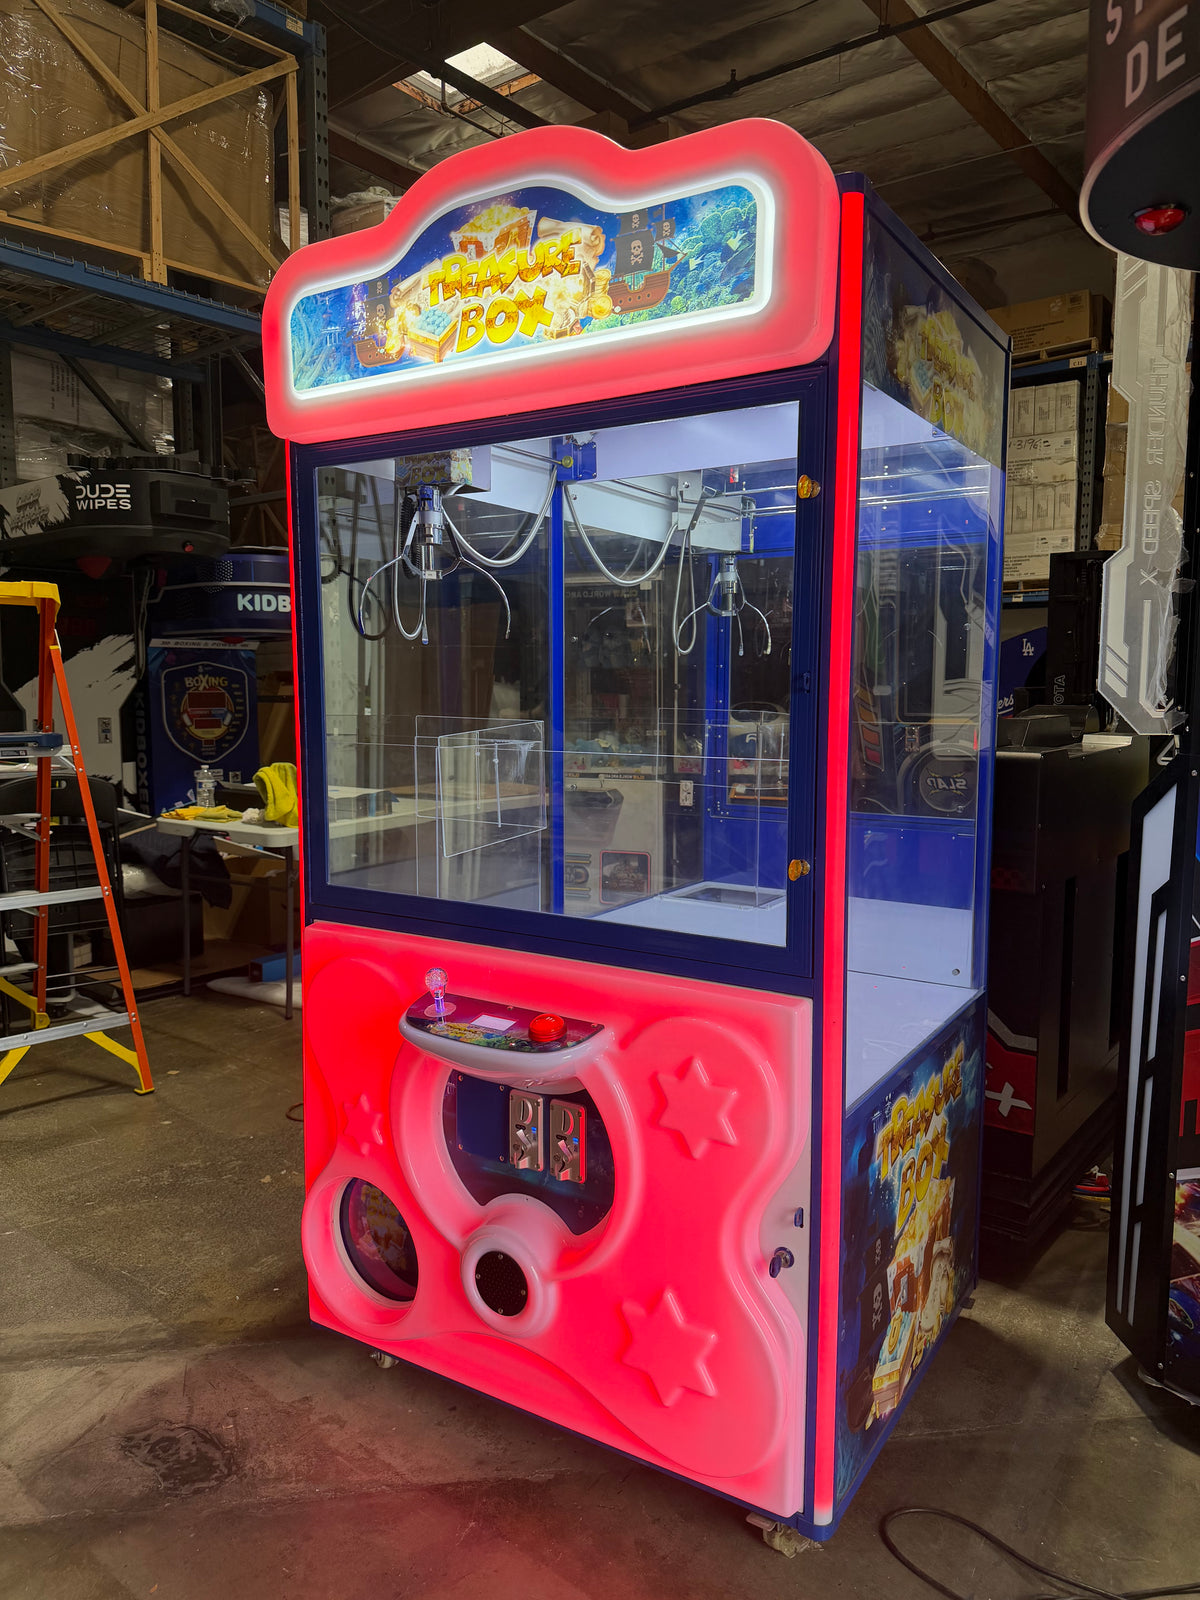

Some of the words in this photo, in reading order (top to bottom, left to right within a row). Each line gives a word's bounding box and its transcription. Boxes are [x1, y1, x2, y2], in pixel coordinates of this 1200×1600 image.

[1106, 0, 1143, 46] S
[422, 227, 582, 306] TREASURE
[456, 286, 554, 353] BOX
[75, 484, 131, 499] DUDE
[76, 499, 132, 510] WIPES
[1022, 638, 1034, 656] LA
[184, 674, 228, 691] BOXING
[1053, 674, 1066, 706] OTA
[876, 1040, 965, 1182] TREASURE
[894, 1117, 950, 1240] BOX
